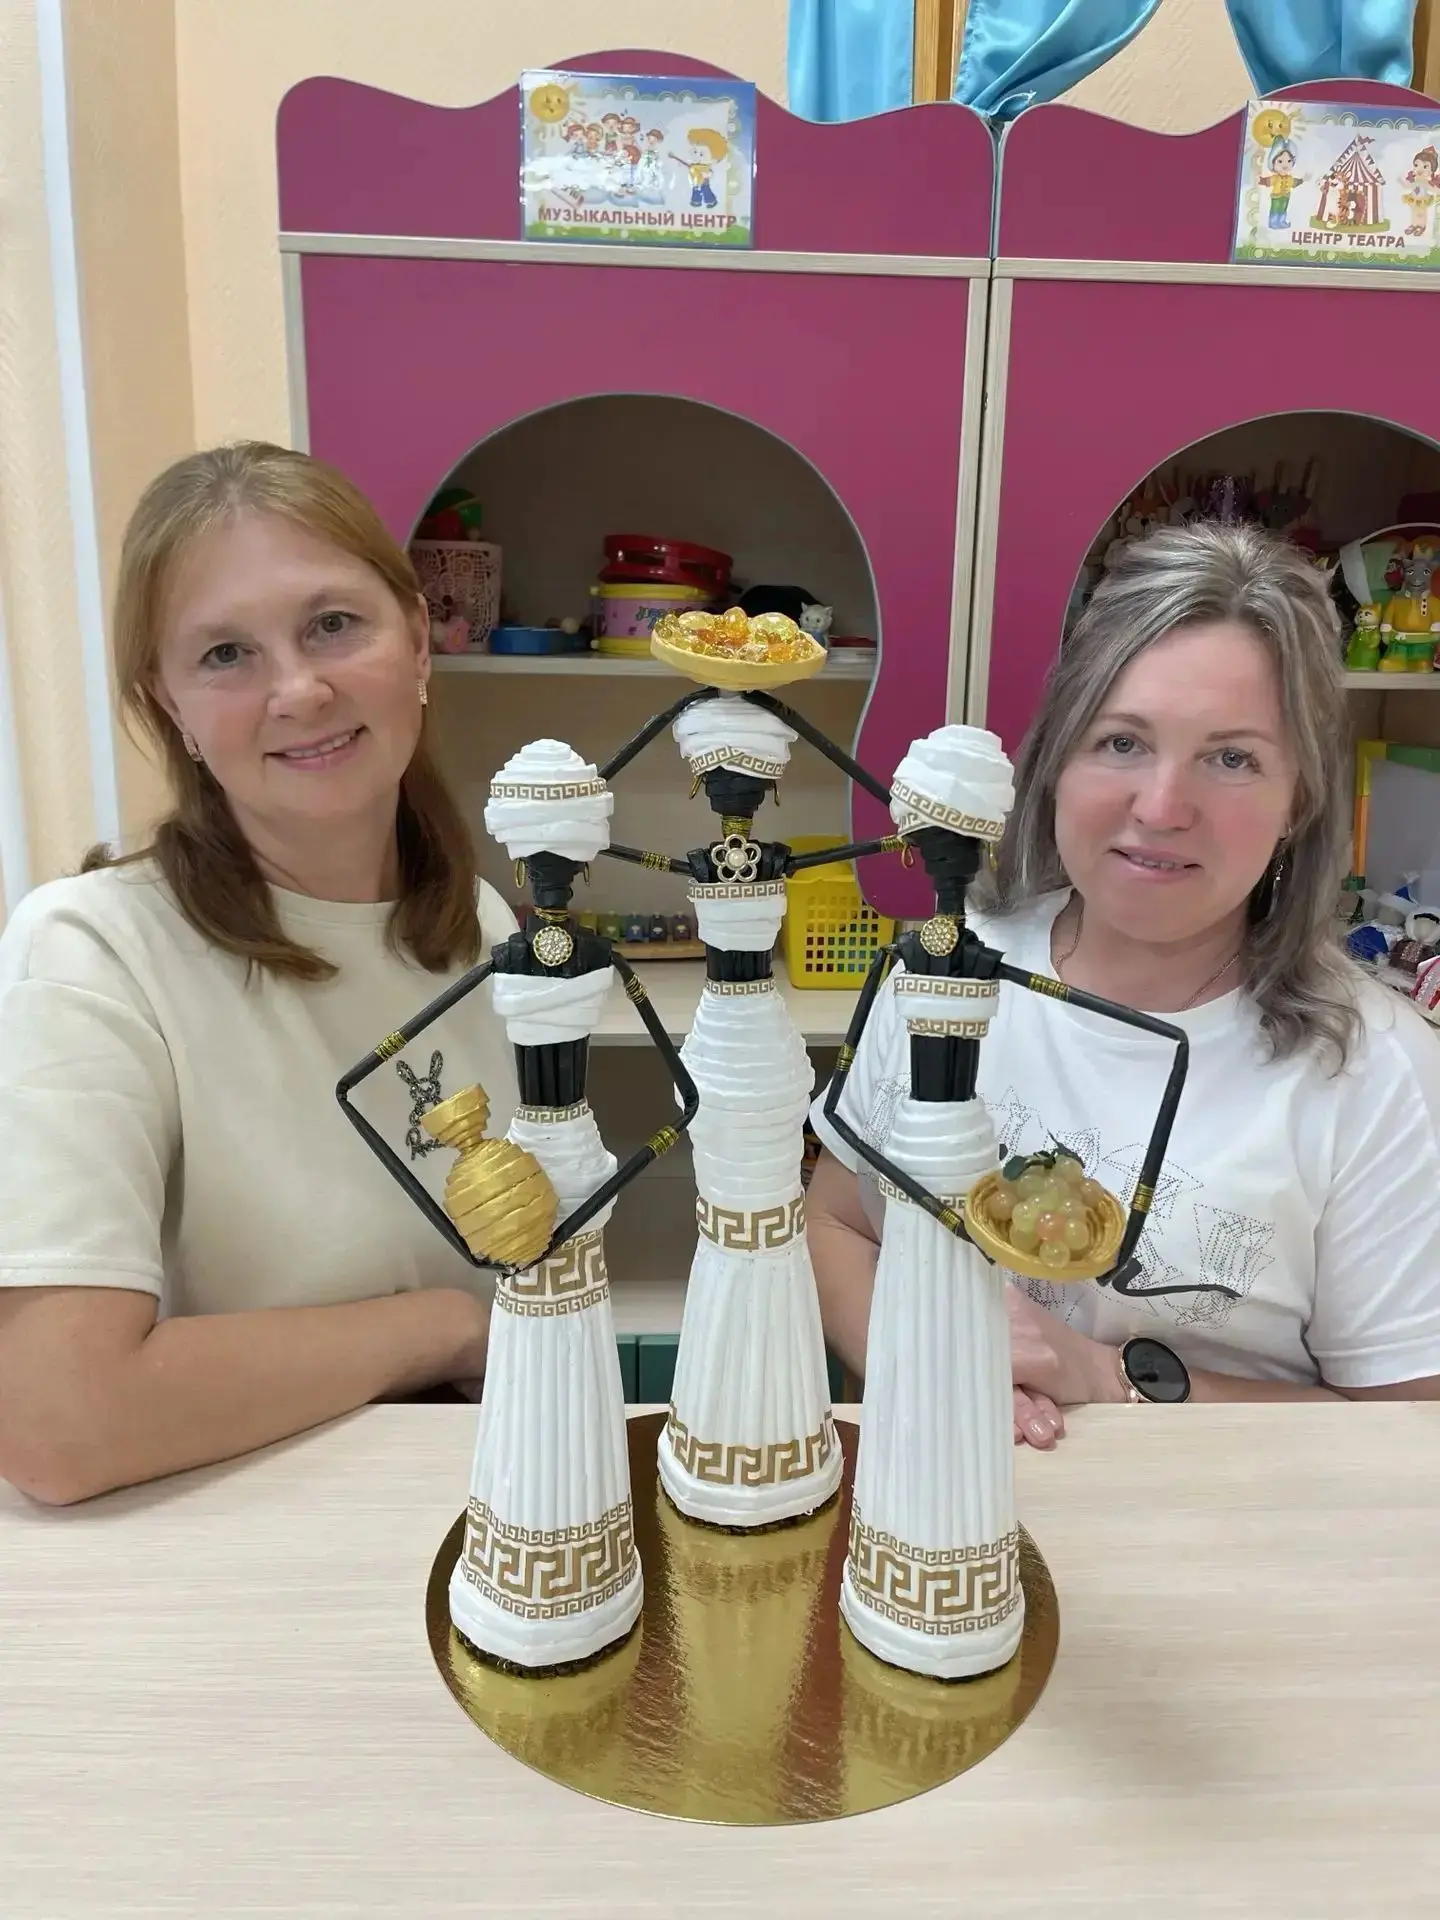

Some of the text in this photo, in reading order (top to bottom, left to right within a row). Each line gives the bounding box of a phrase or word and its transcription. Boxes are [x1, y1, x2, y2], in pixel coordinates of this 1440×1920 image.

[538, 207, 737, 229] МУЗЫКАЛЬНЫЙ ЦЕНТР
[1292, 231, 1405, 248] ЦЕНТР ТЕАТРА
